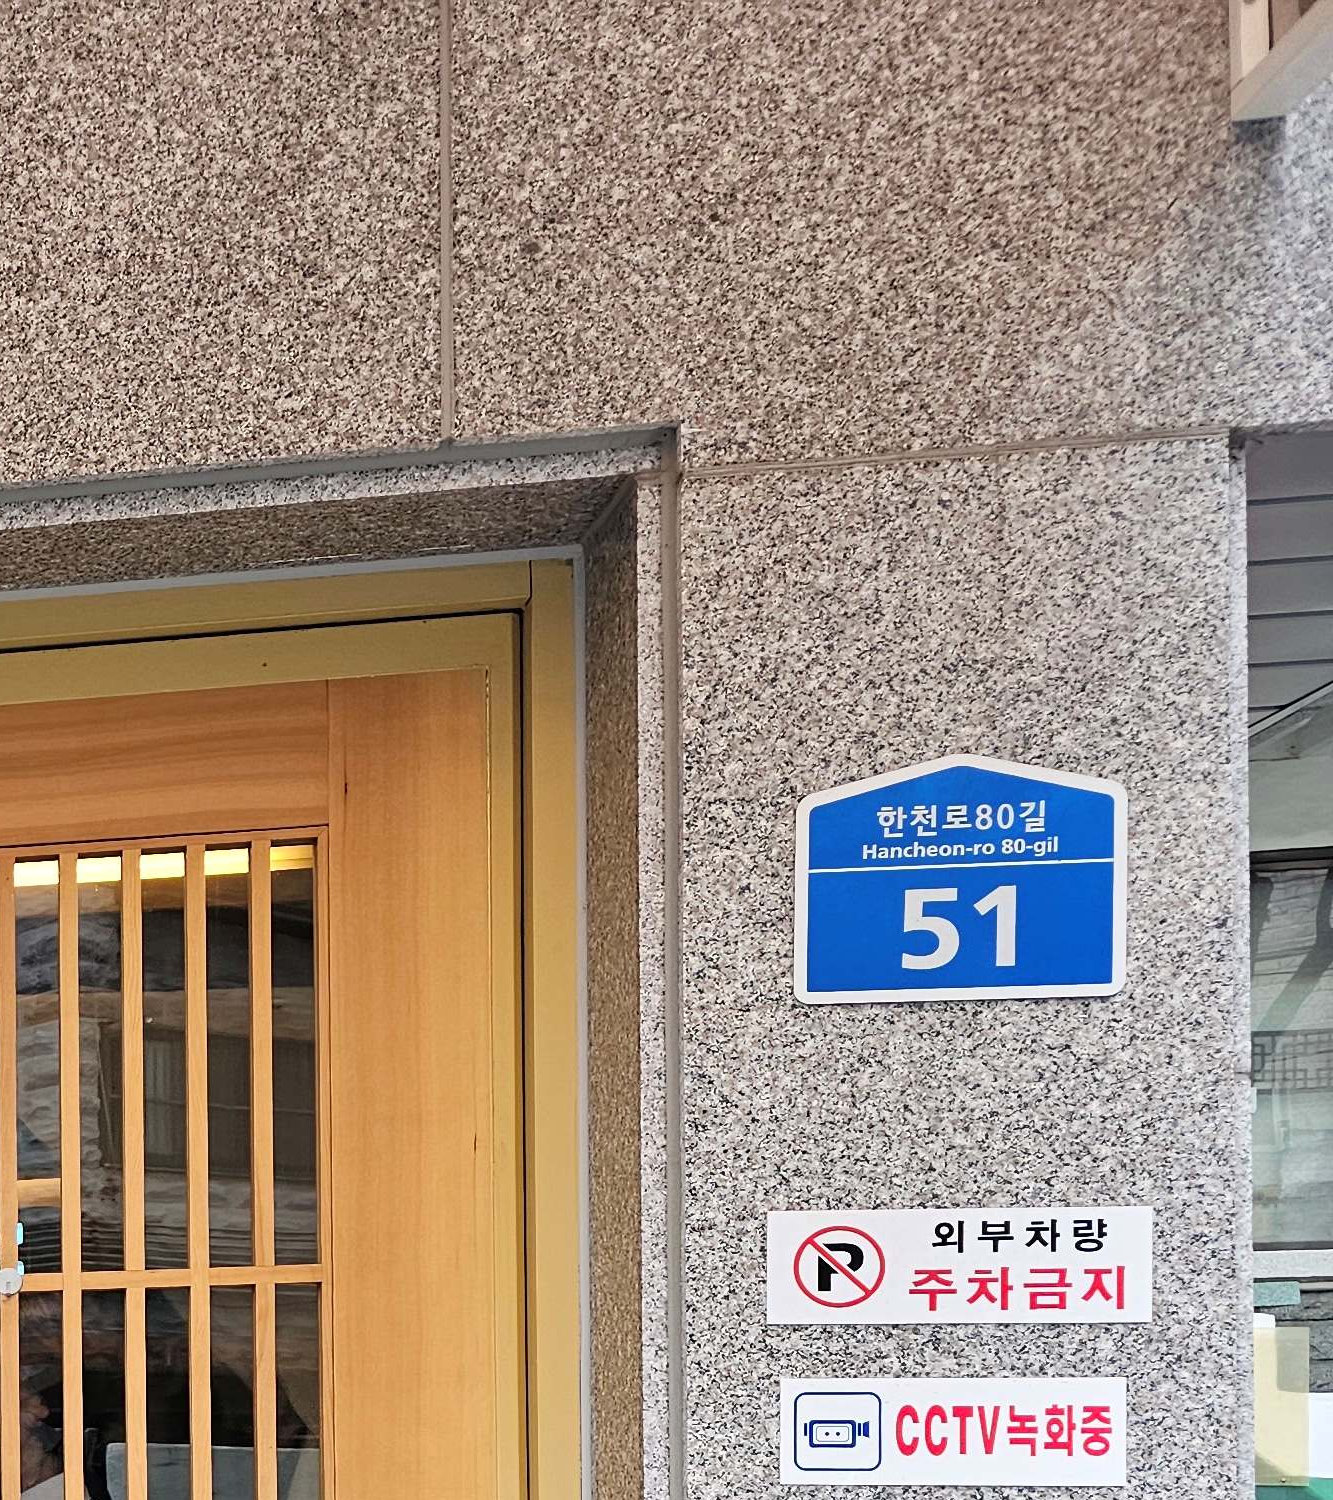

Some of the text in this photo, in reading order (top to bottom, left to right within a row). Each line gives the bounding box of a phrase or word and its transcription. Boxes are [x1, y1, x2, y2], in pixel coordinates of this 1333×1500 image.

[877, 800, 1047, 839] 한천로80길
[862, 837, 1059, 860] Hancheon-ro 80-gil
[901, 885, 1017, 970] 51
[932, 1218, 1108, 1254] 외부차량
[908, 1265, 1126, 1312] 주차금지
[895, 1403, 1112, 1457] CCTV녹화중
